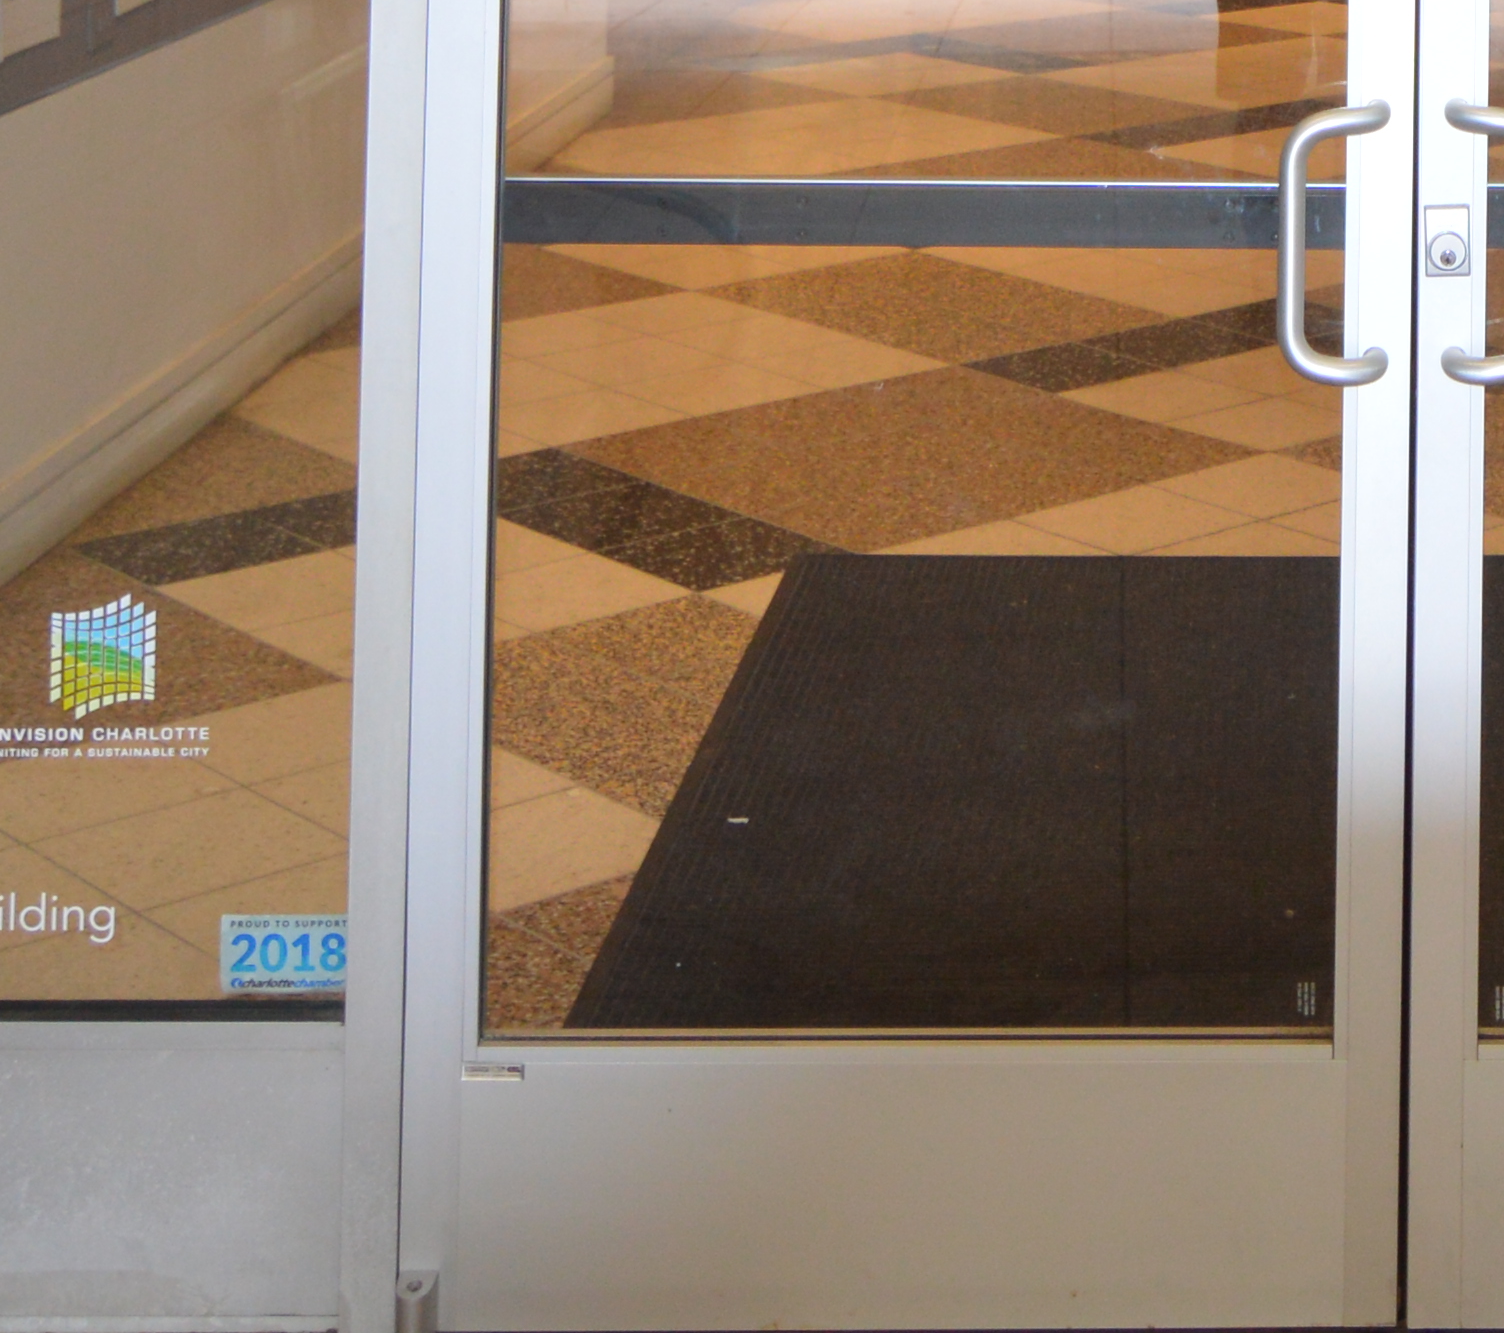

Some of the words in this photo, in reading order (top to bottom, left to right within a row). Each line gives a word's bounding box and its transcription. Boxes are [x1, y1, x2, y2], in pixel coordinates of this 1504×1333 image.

[91, 726, 211, 741] CHARLOTTE
[44, 747, 69, 758] FOR
[73, 747, 83, 758] A
[87, 747, 175, 758] SUSTAINABLE
[180, 746, 210, 758] CITY
[229, 919, 271, 929] PROUD
[275, 919, 291, 929] TO
[294, 919, 349, 929] SUPPORT
[229, 932, 348, 973] 2018
